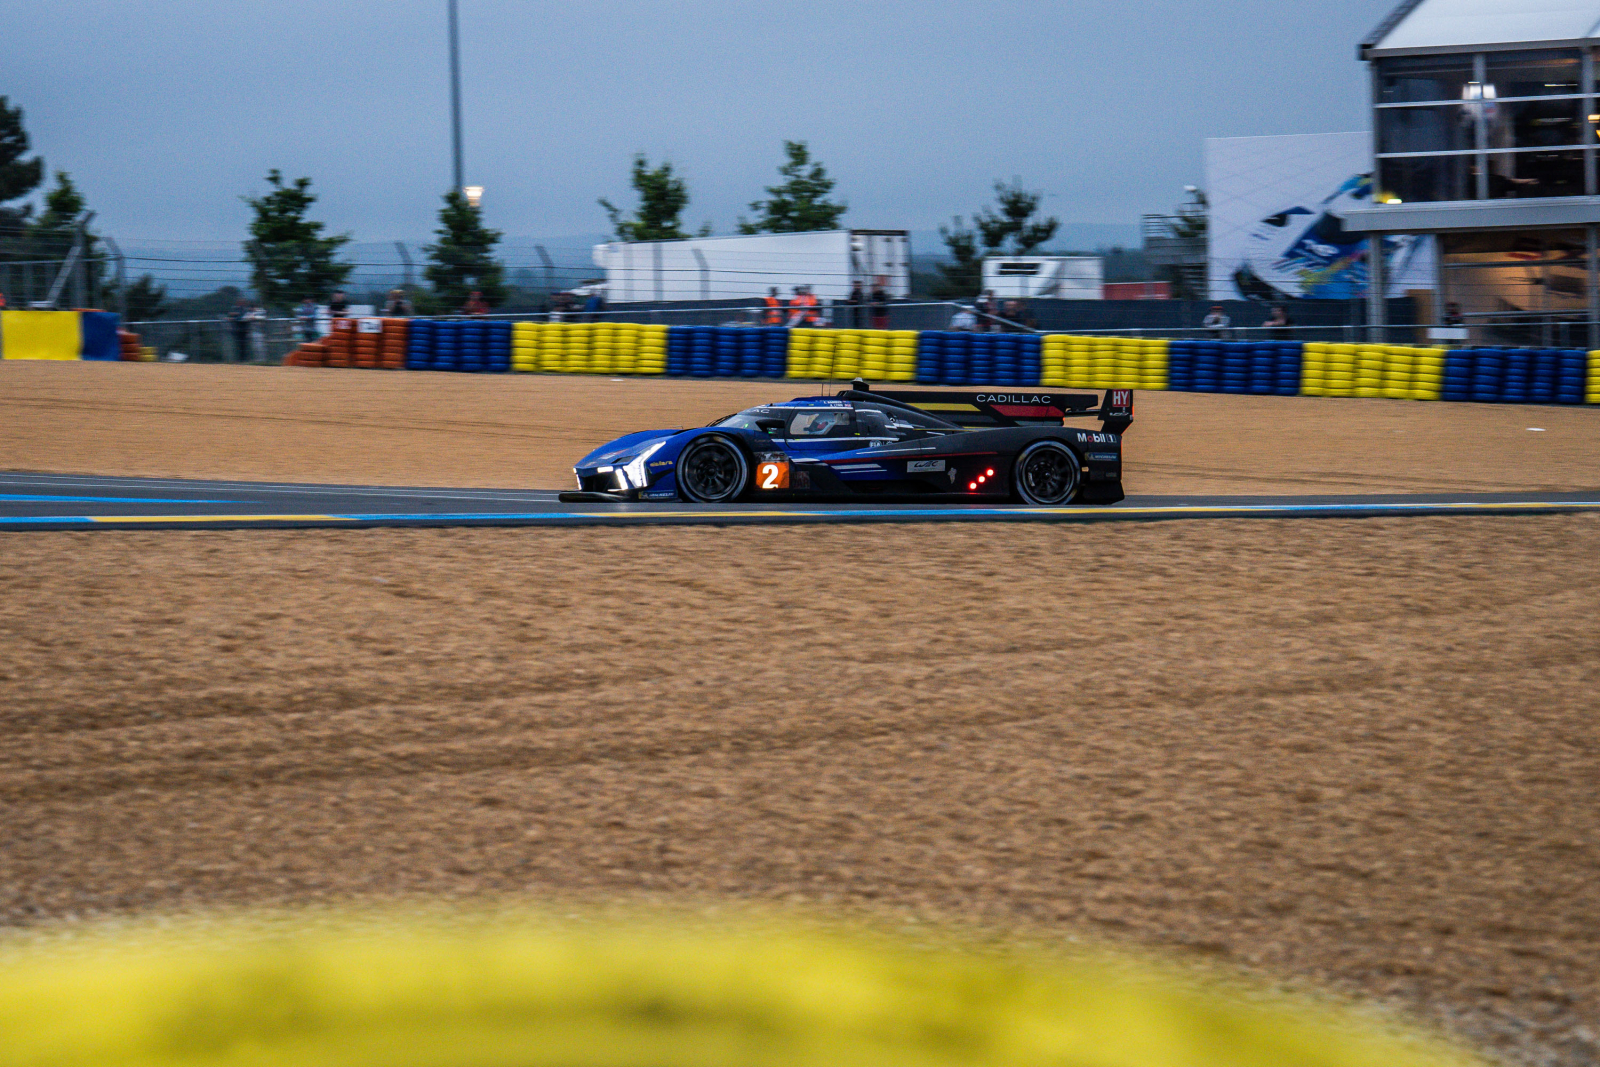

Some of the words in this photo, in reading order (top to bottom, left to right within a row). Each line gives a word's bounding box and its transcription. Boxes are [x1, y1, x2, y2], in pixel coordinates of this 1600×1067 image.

[976, 394, 1051, 404] CADILLAC
[1113, 391, 1129, 405] HY
[1076, 432, 1106, 443] Mobil
[762, 464, 779, 489] 2
